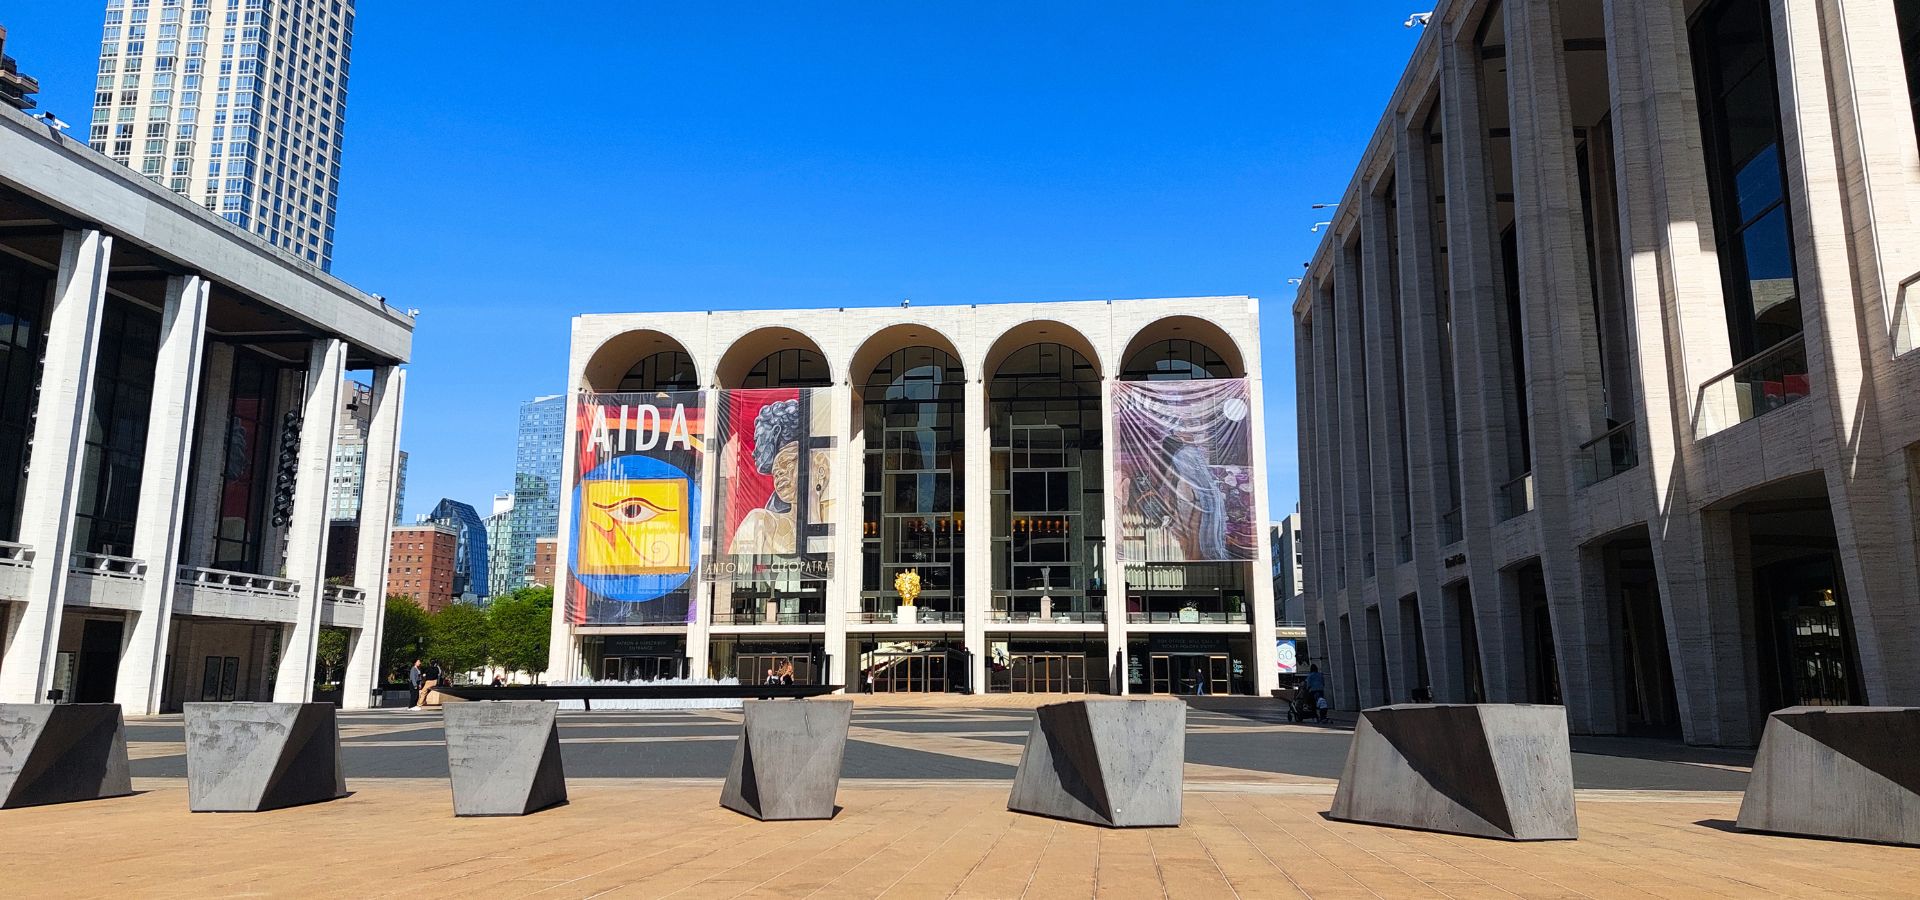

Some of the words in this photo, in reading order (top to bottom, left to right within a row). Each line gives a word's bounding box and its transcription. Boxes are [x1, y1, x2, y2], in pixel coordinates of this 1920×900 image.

[586, 403, 691, 452] AIDA
[705, 562, 750, 575] ANTONY
[754, 564, 768, 573] AND
[771, 560, 830, 573] CLEOPATRA
[1279, 650, 1293, 660] 60
